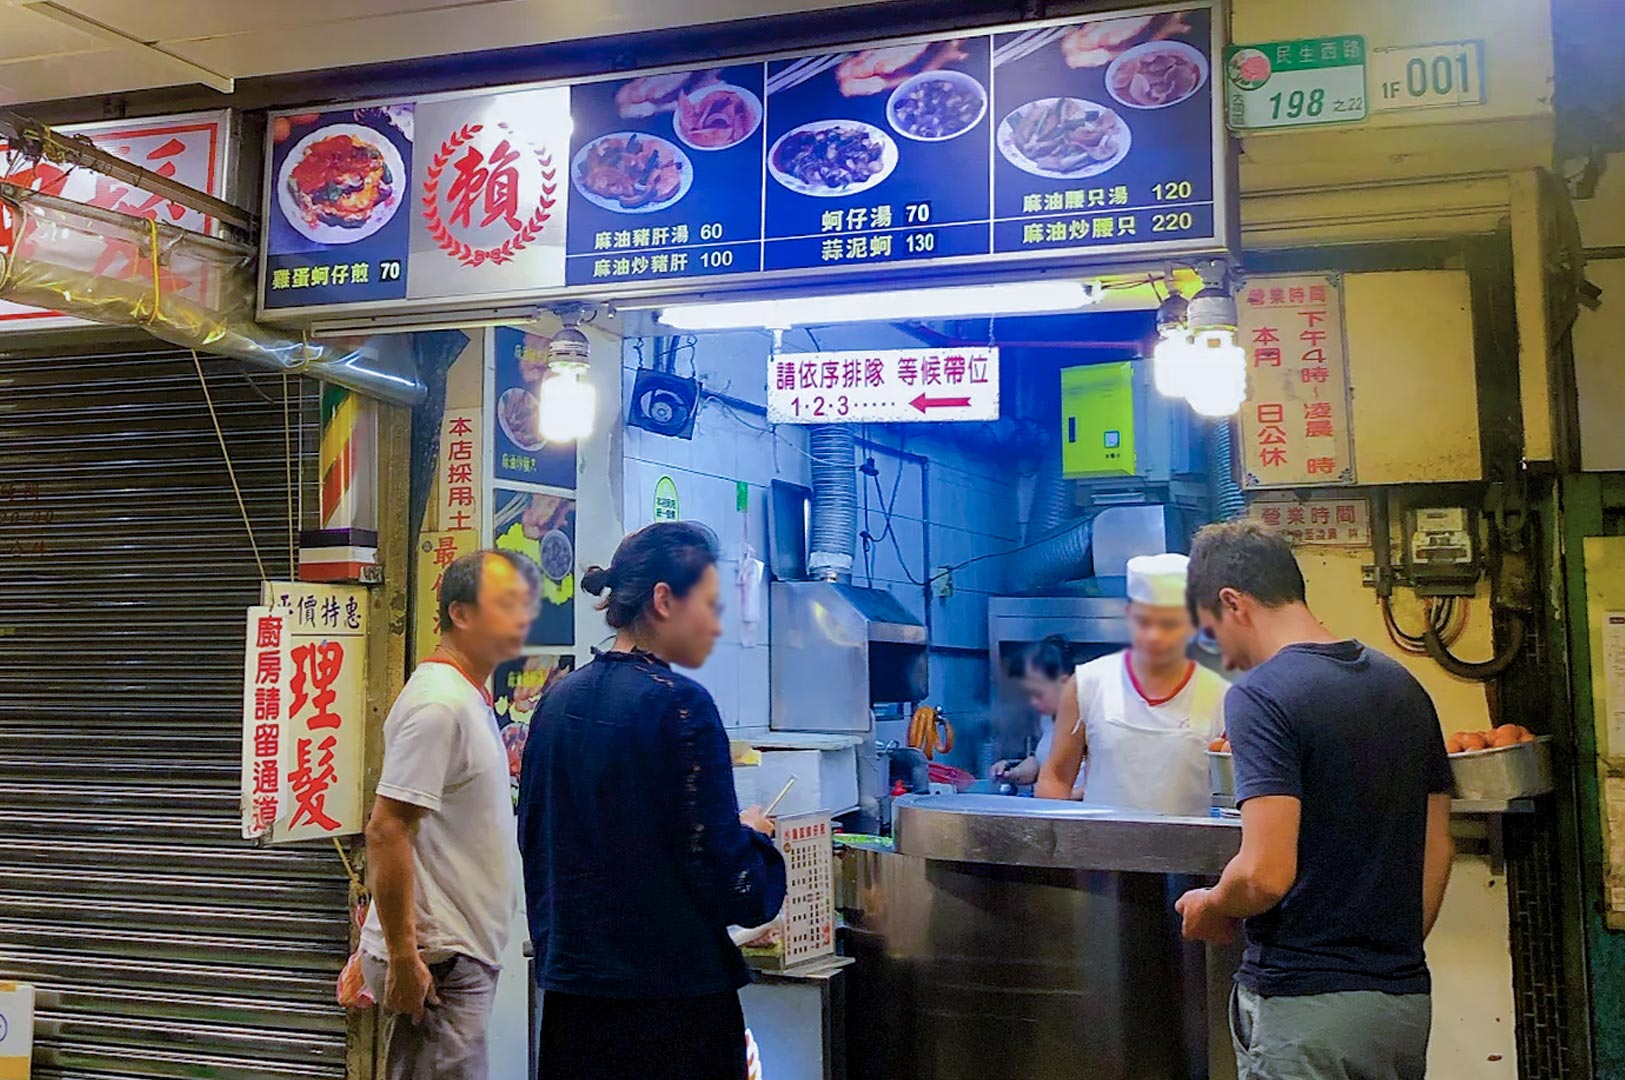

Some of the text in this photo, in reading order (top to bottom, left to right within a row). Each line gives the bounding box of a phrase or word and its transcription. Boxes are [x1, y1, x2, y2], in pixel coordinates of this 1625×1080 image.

[1276, 40, 1360, 64] 民生西路
[1382, 53, 1469, 98] 1F 001
[1270, 88, 1325, 120] 198
[446, 139, 523, 232] 賴
[1152, 181, 1192, 200] 120
[821, 204, 930, 232] 蚵仔湯 70
[1152, 212, 1192, 231] 220
[594, 223, 723, 250] 麻油豬肝湯 60
[821, 233, 934, 261] 蒜泥蚵 130
[271, 262, 400, 290] 雞蛋蚵仔煎 70
[593, 250, 733, 277] 麻油炒豬肝 100
[1248, 285, 1328, 305] 營業時間
[776, 354, 989, 390] 請依序排隊 等候帶位
[1257, 403, 1288, 467] 日公休
[1306, 457, 1335, 475] 時
[1262, 505, 1356, 526] 營業時間
[288, 641, 345, 831] 理髮
